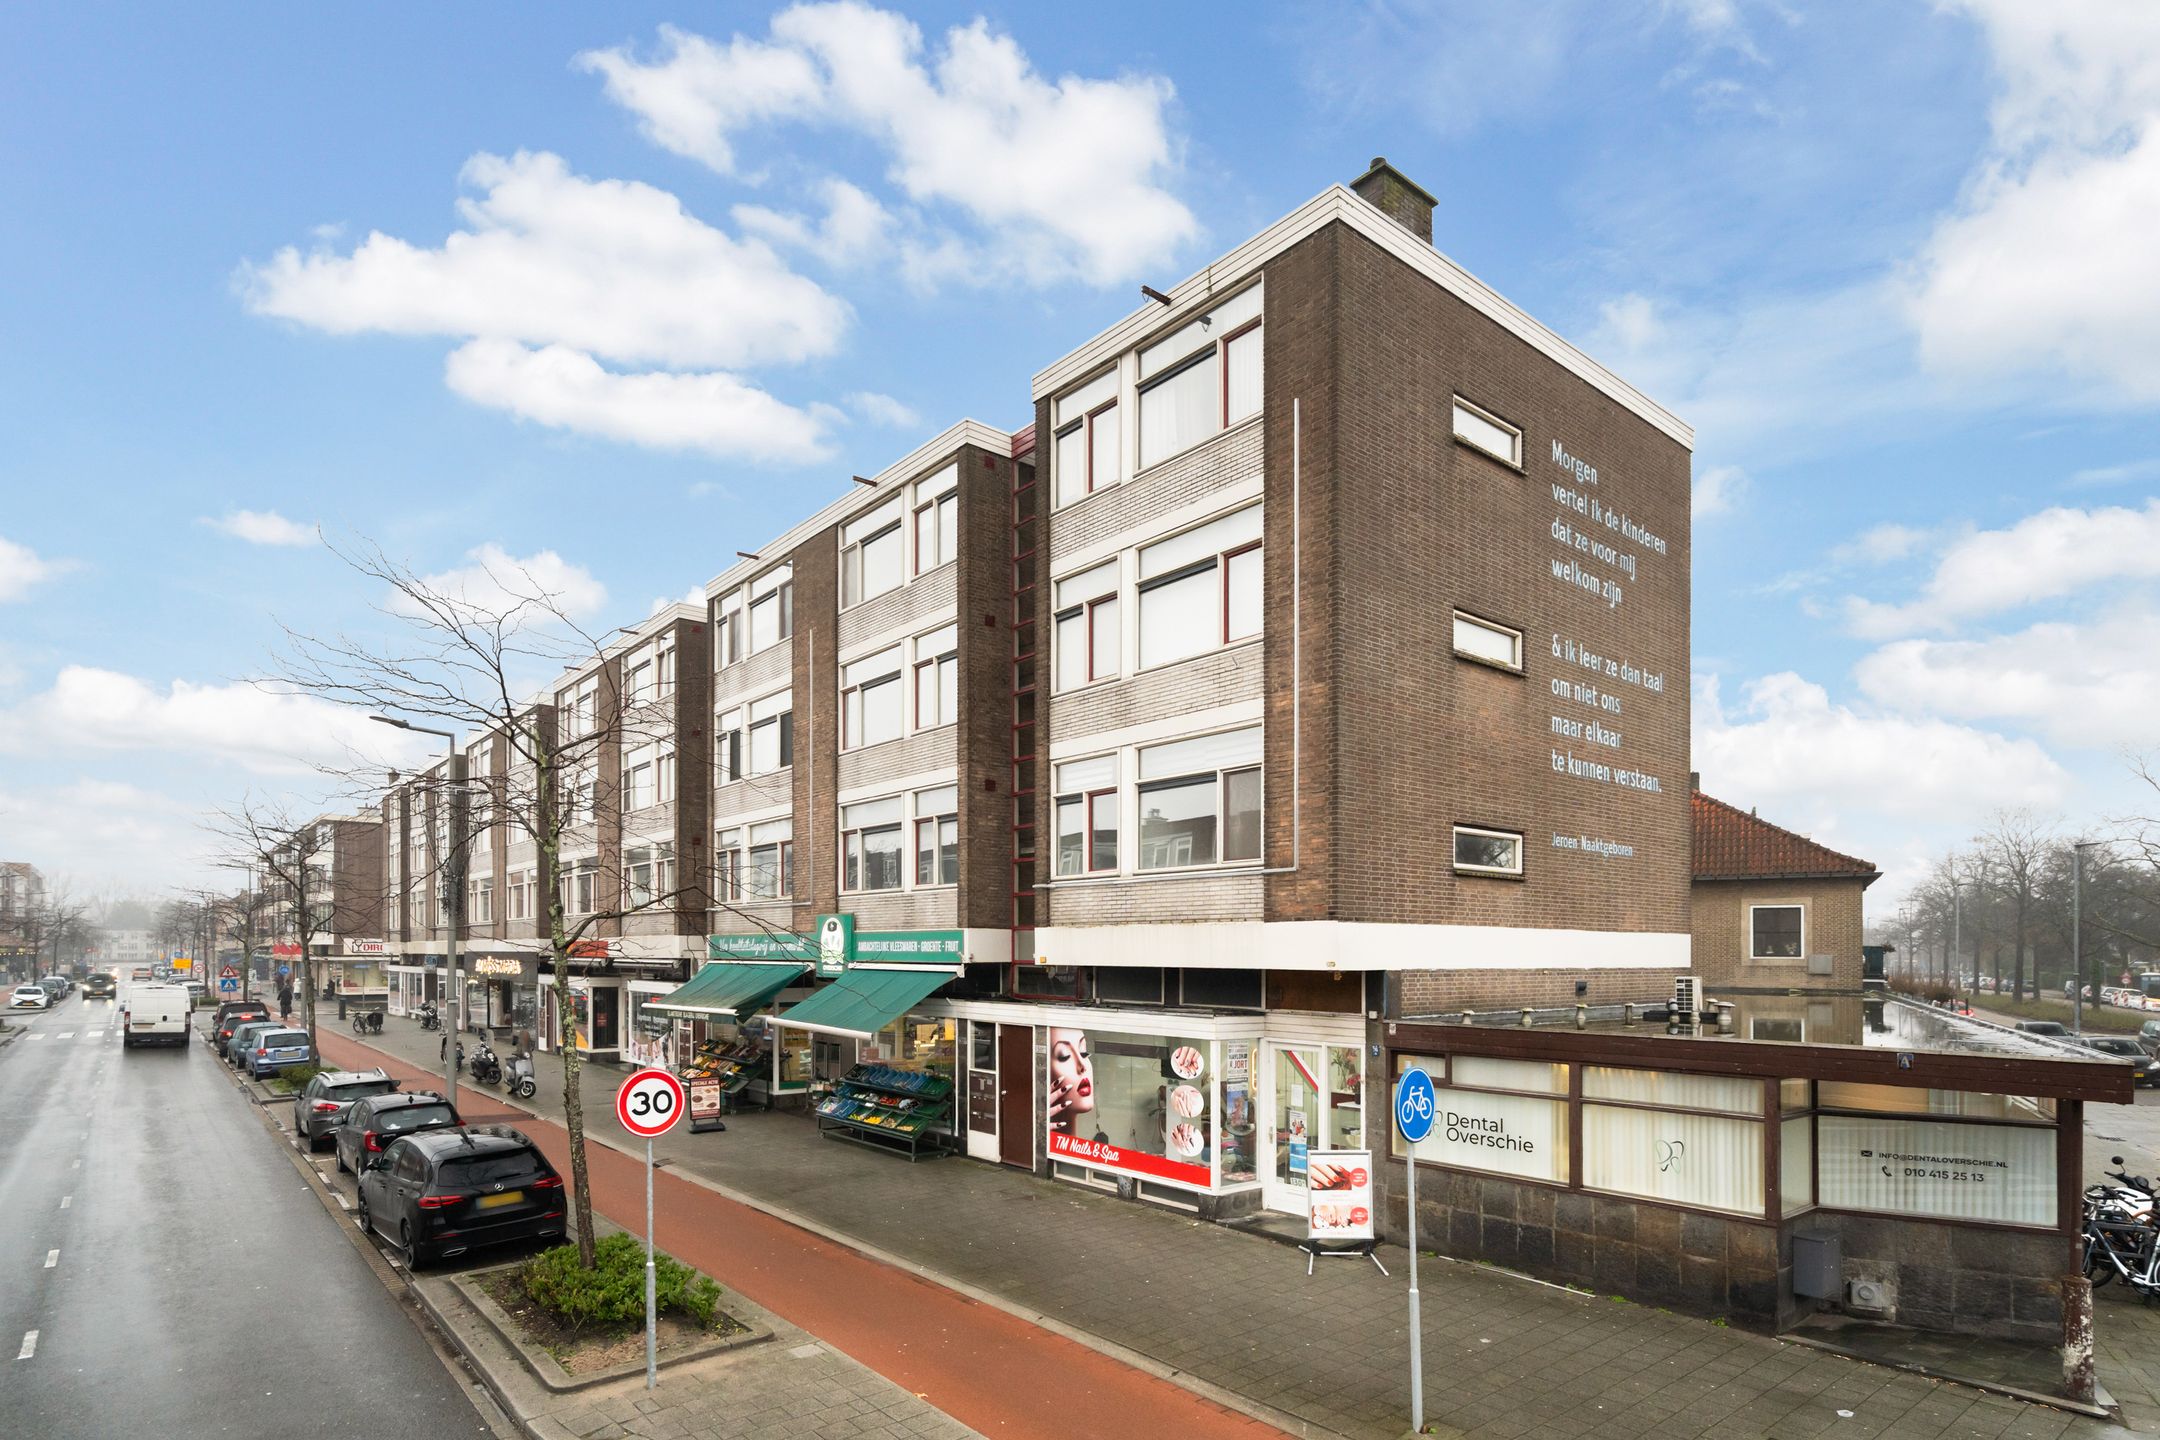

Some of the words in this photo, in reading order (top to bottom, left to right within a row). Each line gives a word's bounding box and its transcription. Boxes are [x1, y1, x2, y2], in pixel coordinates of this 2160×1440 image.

[1552, 439, 1597, 484] Morgen
[1552, 483, 1588, 515] vertel
[1591, 499, 1602, 523] ik
[1605, 507, 1619, 531] de
[1622, 514, 1666, 555] kinderen
[1551, 517, 1572, 545] dat
[1575, 532, 1588, 551] ze
[1591, 540, 1617, 563] voor
[1620, 552, 1636, 581] mij
[1552, 559, 1599, 594] welkom
[1602, 580, 1622, 608] zijn
[1552, 633, 1562, 658] &
[1565, 640, 1576, 663] ik
[1580, 643, 1602, 670] leer
[1605, 659, 1617, 678] ze
[1620, 660, 1640, 685] dan
[1643, 668, 1663, 692] taal
[1552, 679, 1570, 698] om
[1574, 683, 1597, 706] niet
[1601, 695, 1621, 713] ons
[1551, 715, 1582, 738] maar
[1586, 721, 1622, 748] elkaar
[1552, 749, 1564, 772] te
[1568, 751, 1610, 782] kunnen
[1614, 768, 1662, 793] verstaan.
[1551, 832, 1577, 849] Jeroen
[1581, 836, 1633, 857] Naaktgeboren
[945, 941, 959, 952] FRUIT
[1900, 1056, 1911, 1068] A
[632, 1090, 673, 1116] 30
[1447, 1112, 1503, 1133] Dental
[1056, 1136, 1069, 1151] TM
[1070, 1139, 1091, 1155] Nails
[1093, 1143, 1100, 1157] &
[1100, 1145, 1119, 1163] Spa
[1446, 1127, 1534, 1153] Overschie
[1879, 1152, 2008, 1168] INFO@DENTALOVERSCHIE.NL
[1904, 1167, 1926, 1177] 010
[1929, 1170, 1949, 1179] 415
[1952, 1171, 1967, 1181] 25
[1971, 1173, 1984, 1182] 13
